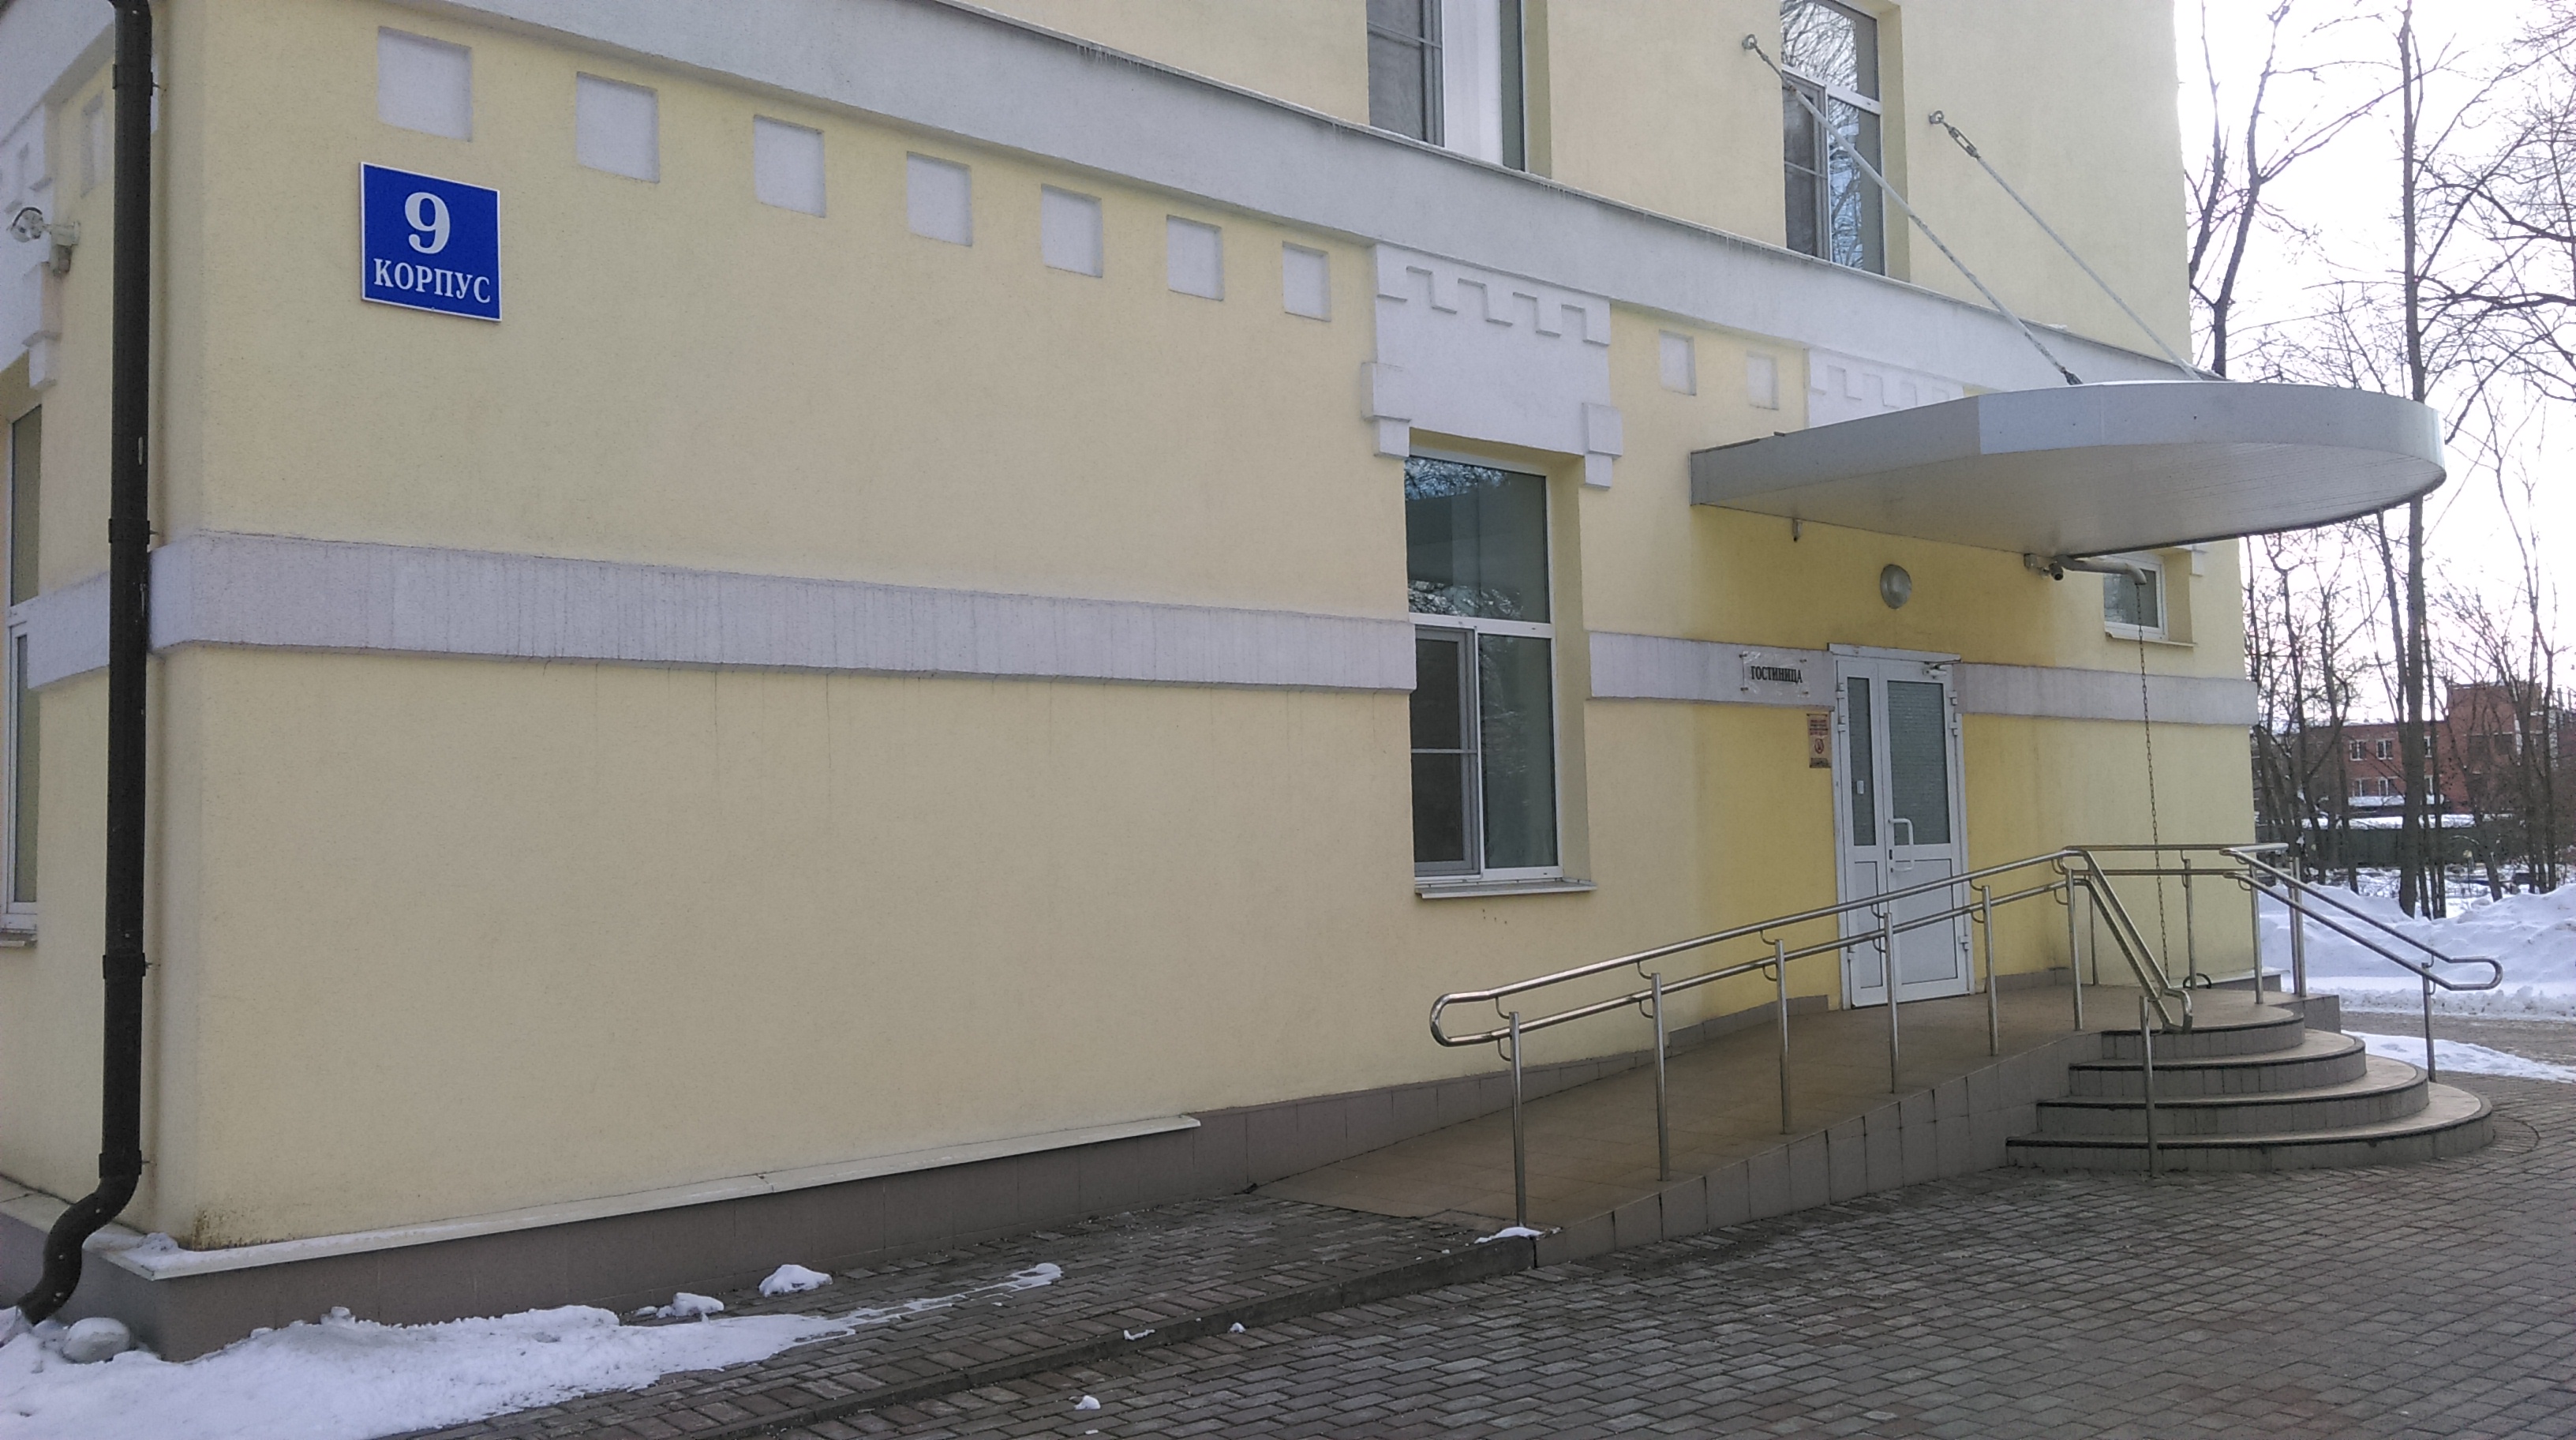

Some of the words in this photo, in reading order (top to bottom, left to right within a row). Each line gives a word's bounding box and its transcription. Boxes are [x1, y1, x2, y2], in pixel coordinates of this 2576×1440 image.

[405, 192, 451, 254] 9
[373, 258, 491, 303] КОРПУС
[1750, 666, 1803, 684] ГОСТИНИЦА
